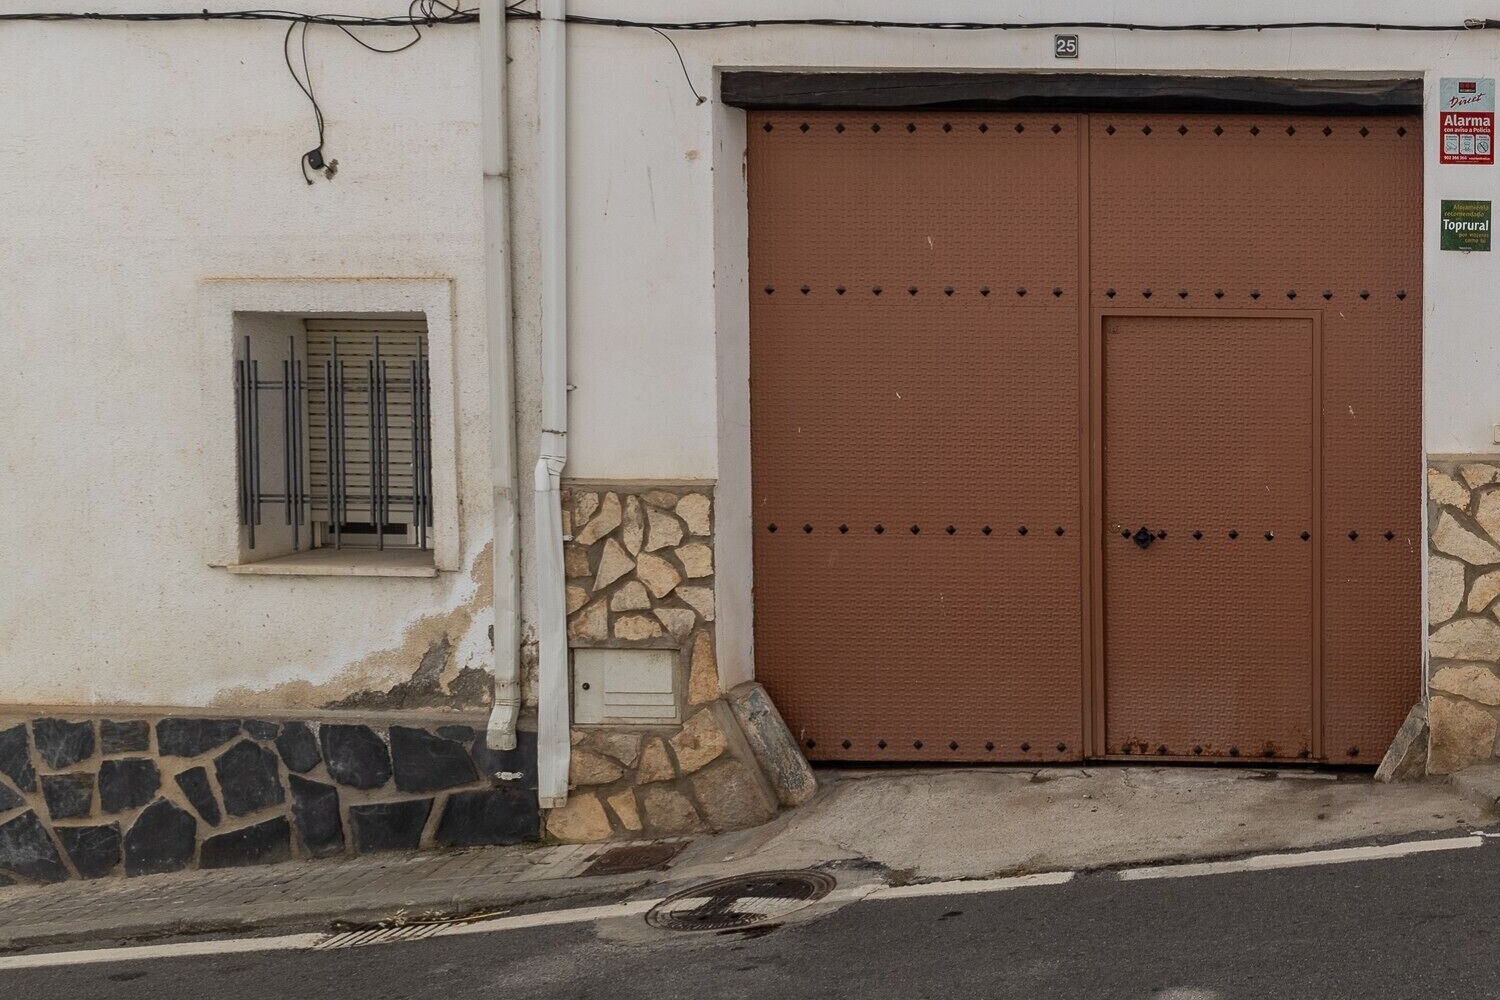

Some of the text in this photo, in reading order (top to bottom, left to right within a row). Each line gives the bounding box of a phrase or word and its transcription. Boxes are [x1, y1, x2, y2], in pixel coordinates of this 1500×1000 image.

[1057, 39, 1076, 53] 25
[1449, 92, 1486, 108] Direct
[1443, 114, 1491, 126] Alarma
[1443, 218, 1489, 233] Toprural
